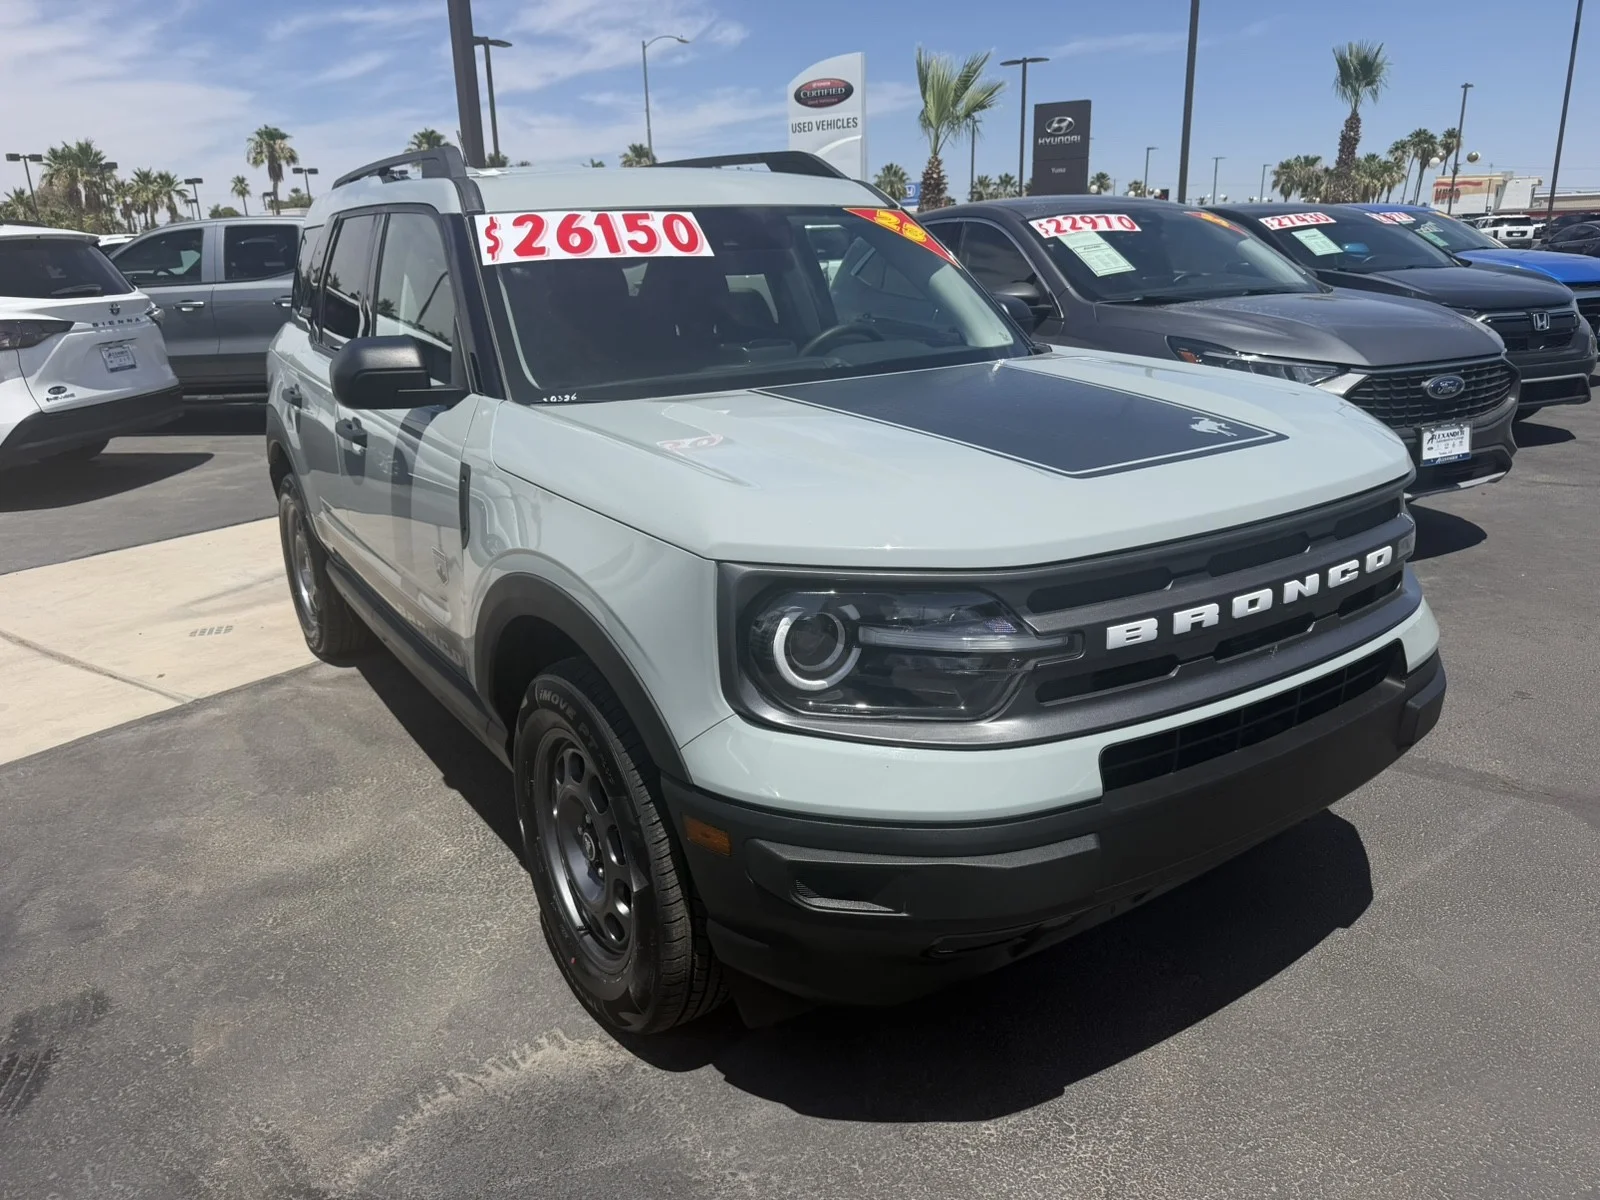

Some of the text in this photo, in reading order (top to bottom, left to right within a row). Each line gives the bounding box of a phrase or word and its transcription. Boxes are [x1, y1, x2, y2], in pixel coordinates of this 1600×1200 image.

[801, 87, 845, 98] CERTIFIED
[791, 117, 858, 134] USED VEHICLES
[1038, 135, 1081, 146] HYUNDAI
[1038, 215, 1136, 236] $22970
[485, 212, 705, 262] $26150
[1106, 545, 1393, 650] BRONCO
